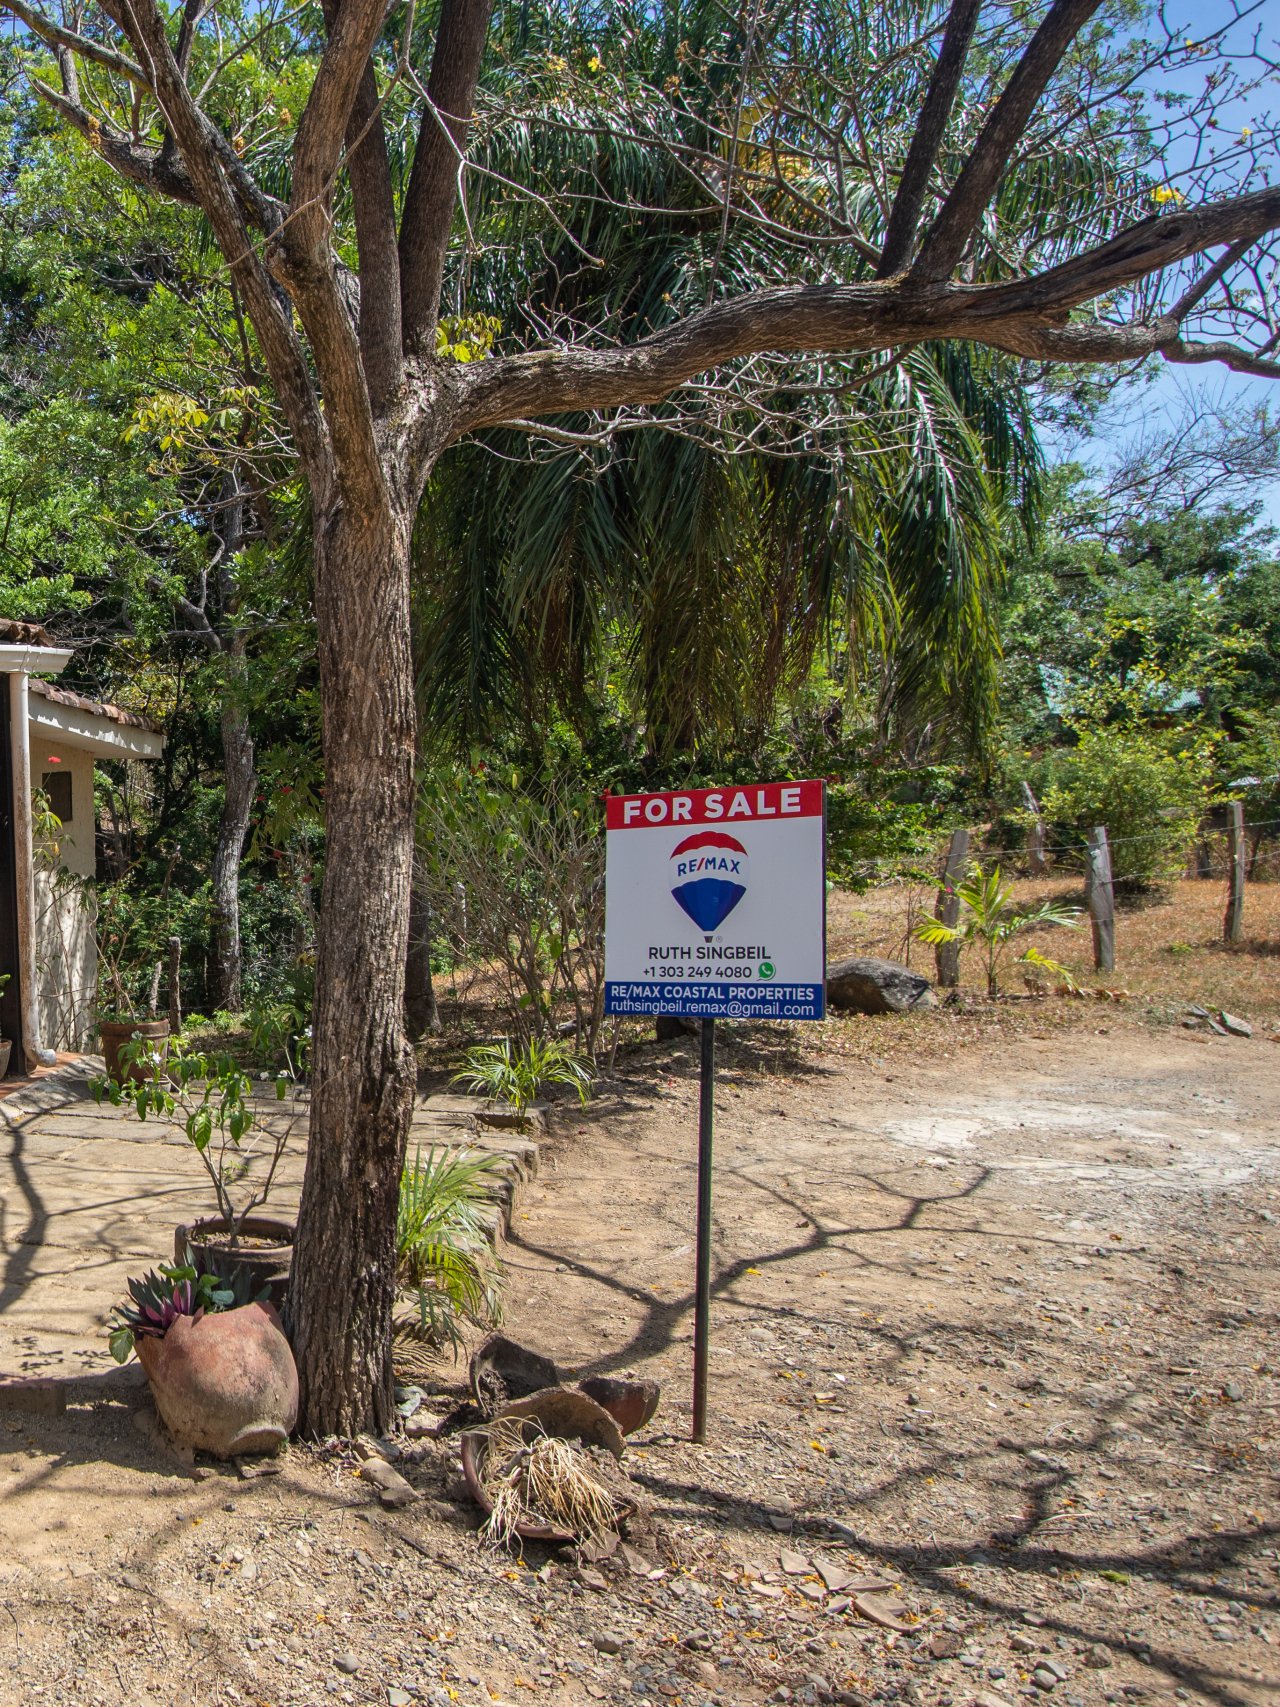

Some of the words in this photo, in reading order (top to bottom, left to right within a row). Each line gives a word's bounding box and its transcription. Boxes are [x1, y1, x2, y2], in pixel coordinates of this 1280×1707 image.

[623, 797, 692, 824] FOR
[704, 787, 801, 819] SALE
[677, 857, 741, 877] RE/MAX
[648, 946, 691, 960] RUTH
[696, 946, 771, 960] SINGBEIL
[643, 966, 655, 977] +1
[659, 966, 684, 978] 303
[688, 966, 712, 978] 249
[715, 966, 752, 978] 4080
[611, 984, 661, 998] RE/MAX
[664, 986, 725, 999] COASTAL
[729, 987, 814, 1001] PROPERTIES
[611, 1000, 814, 1017] ruthsingbeil.remax@gmail.com
